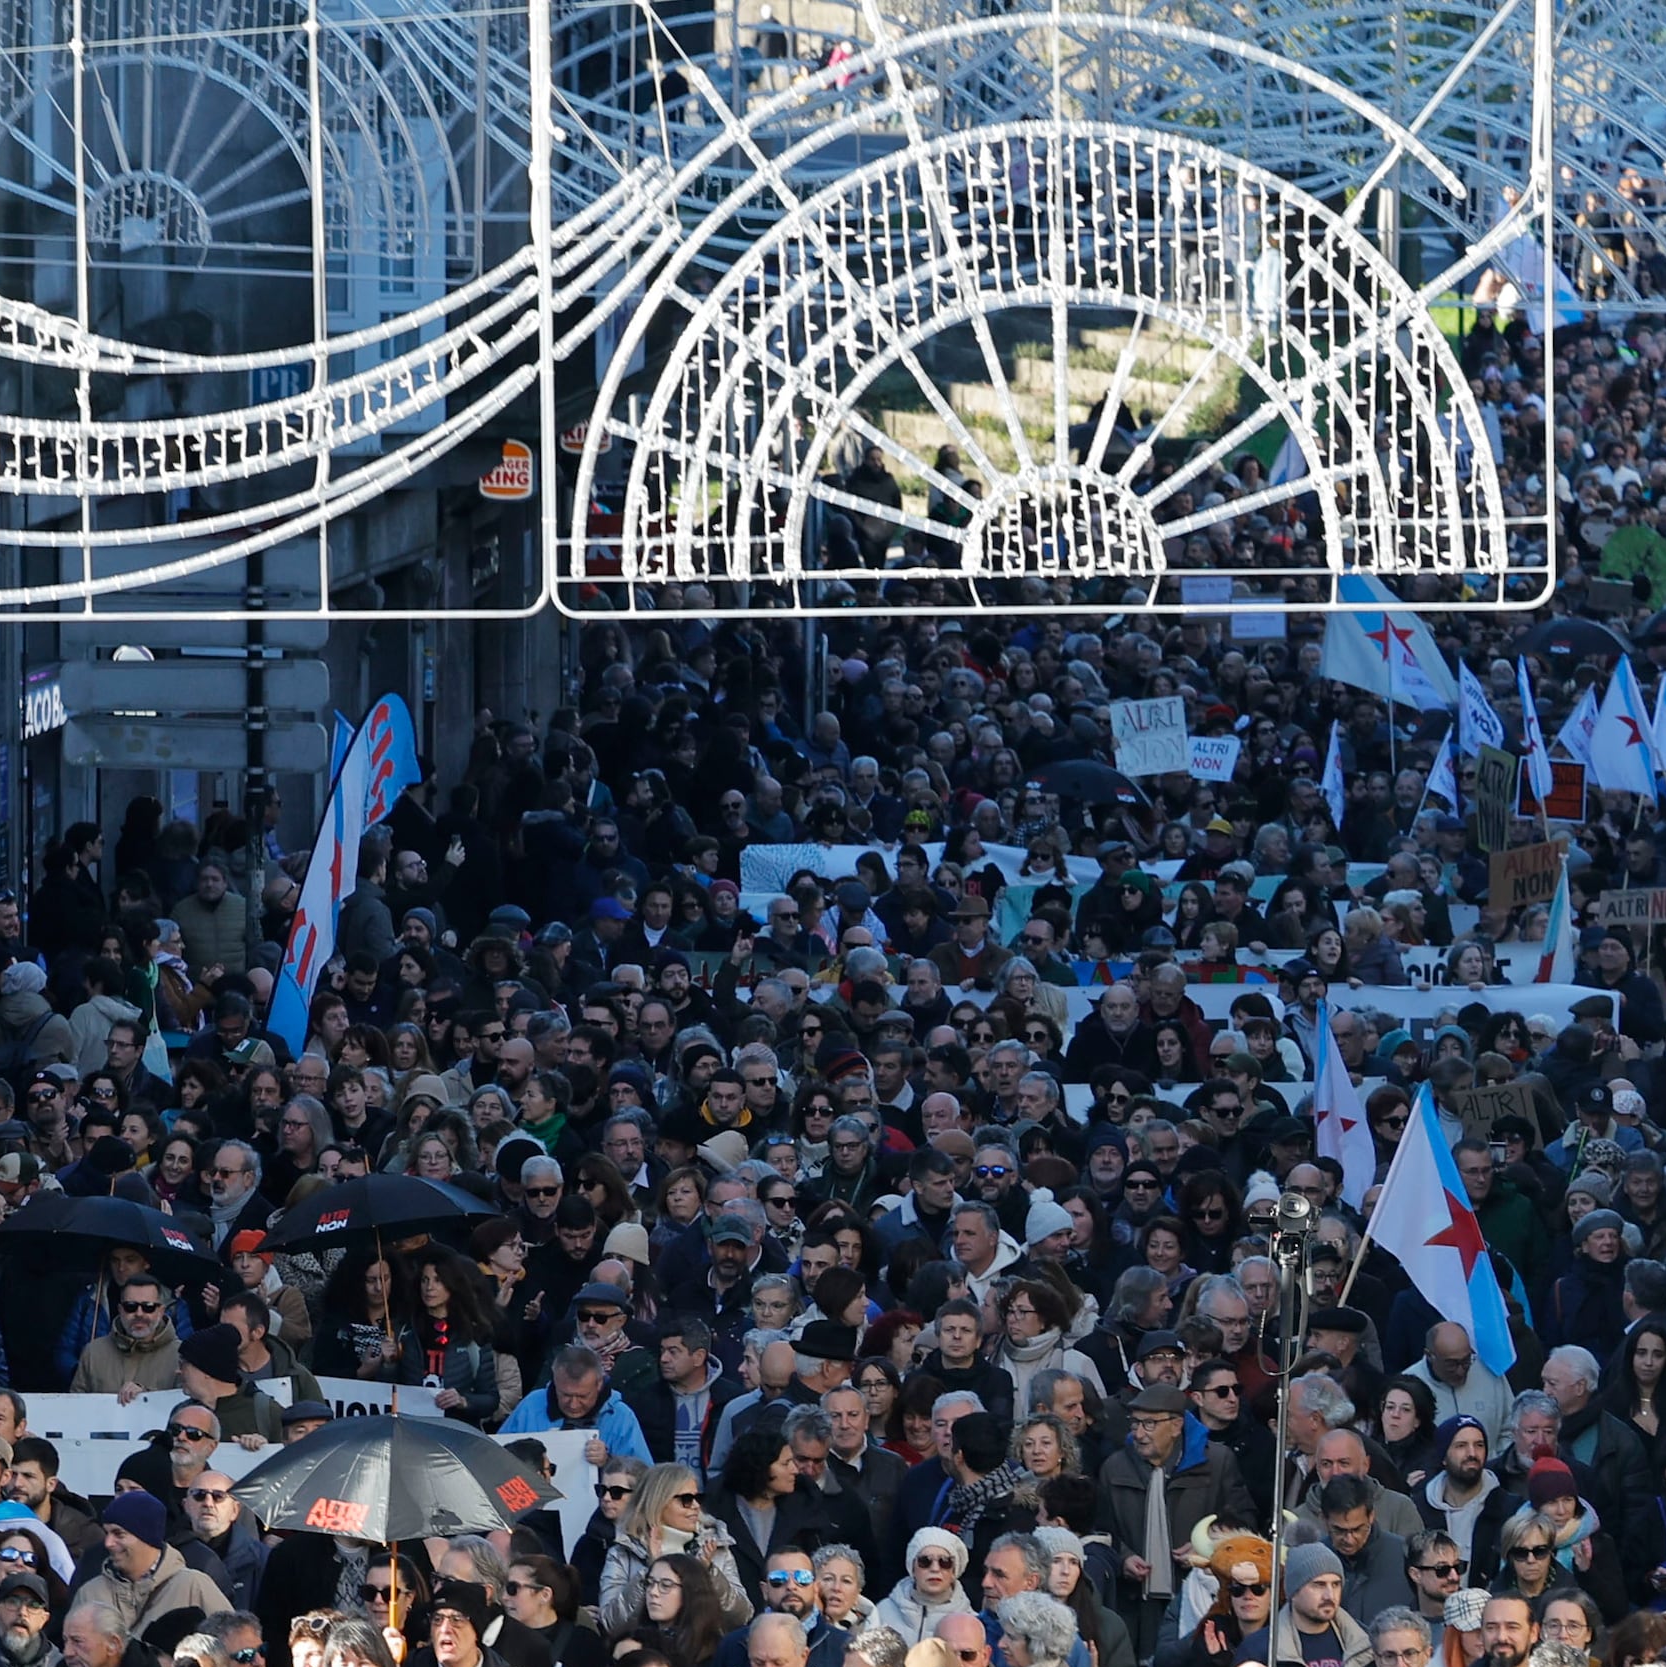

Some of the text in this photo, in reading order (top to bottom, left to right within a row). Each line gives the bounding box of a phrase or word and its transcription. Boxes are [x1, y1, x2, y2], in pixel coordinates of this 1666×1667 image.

[481, 471, 530, 486] KING
[1193, 741, 1230, 756] ALTRI
[1192, 758, 1224, 772] NON
[1504, 845, 1560, 882] ALTRI
[1514, 871, 1555, 901] NON
[1604, 896, 1651, 920] ALTRI
[1463, 1087, 1530, 1122] ALTRI
[318, 1208, 351, 1224] ALTRI
[315, 1219, 348, 1233] NON
[165, 1236, 194, 1251] NON
[310, 1497, 370, 1521] ALTRI
